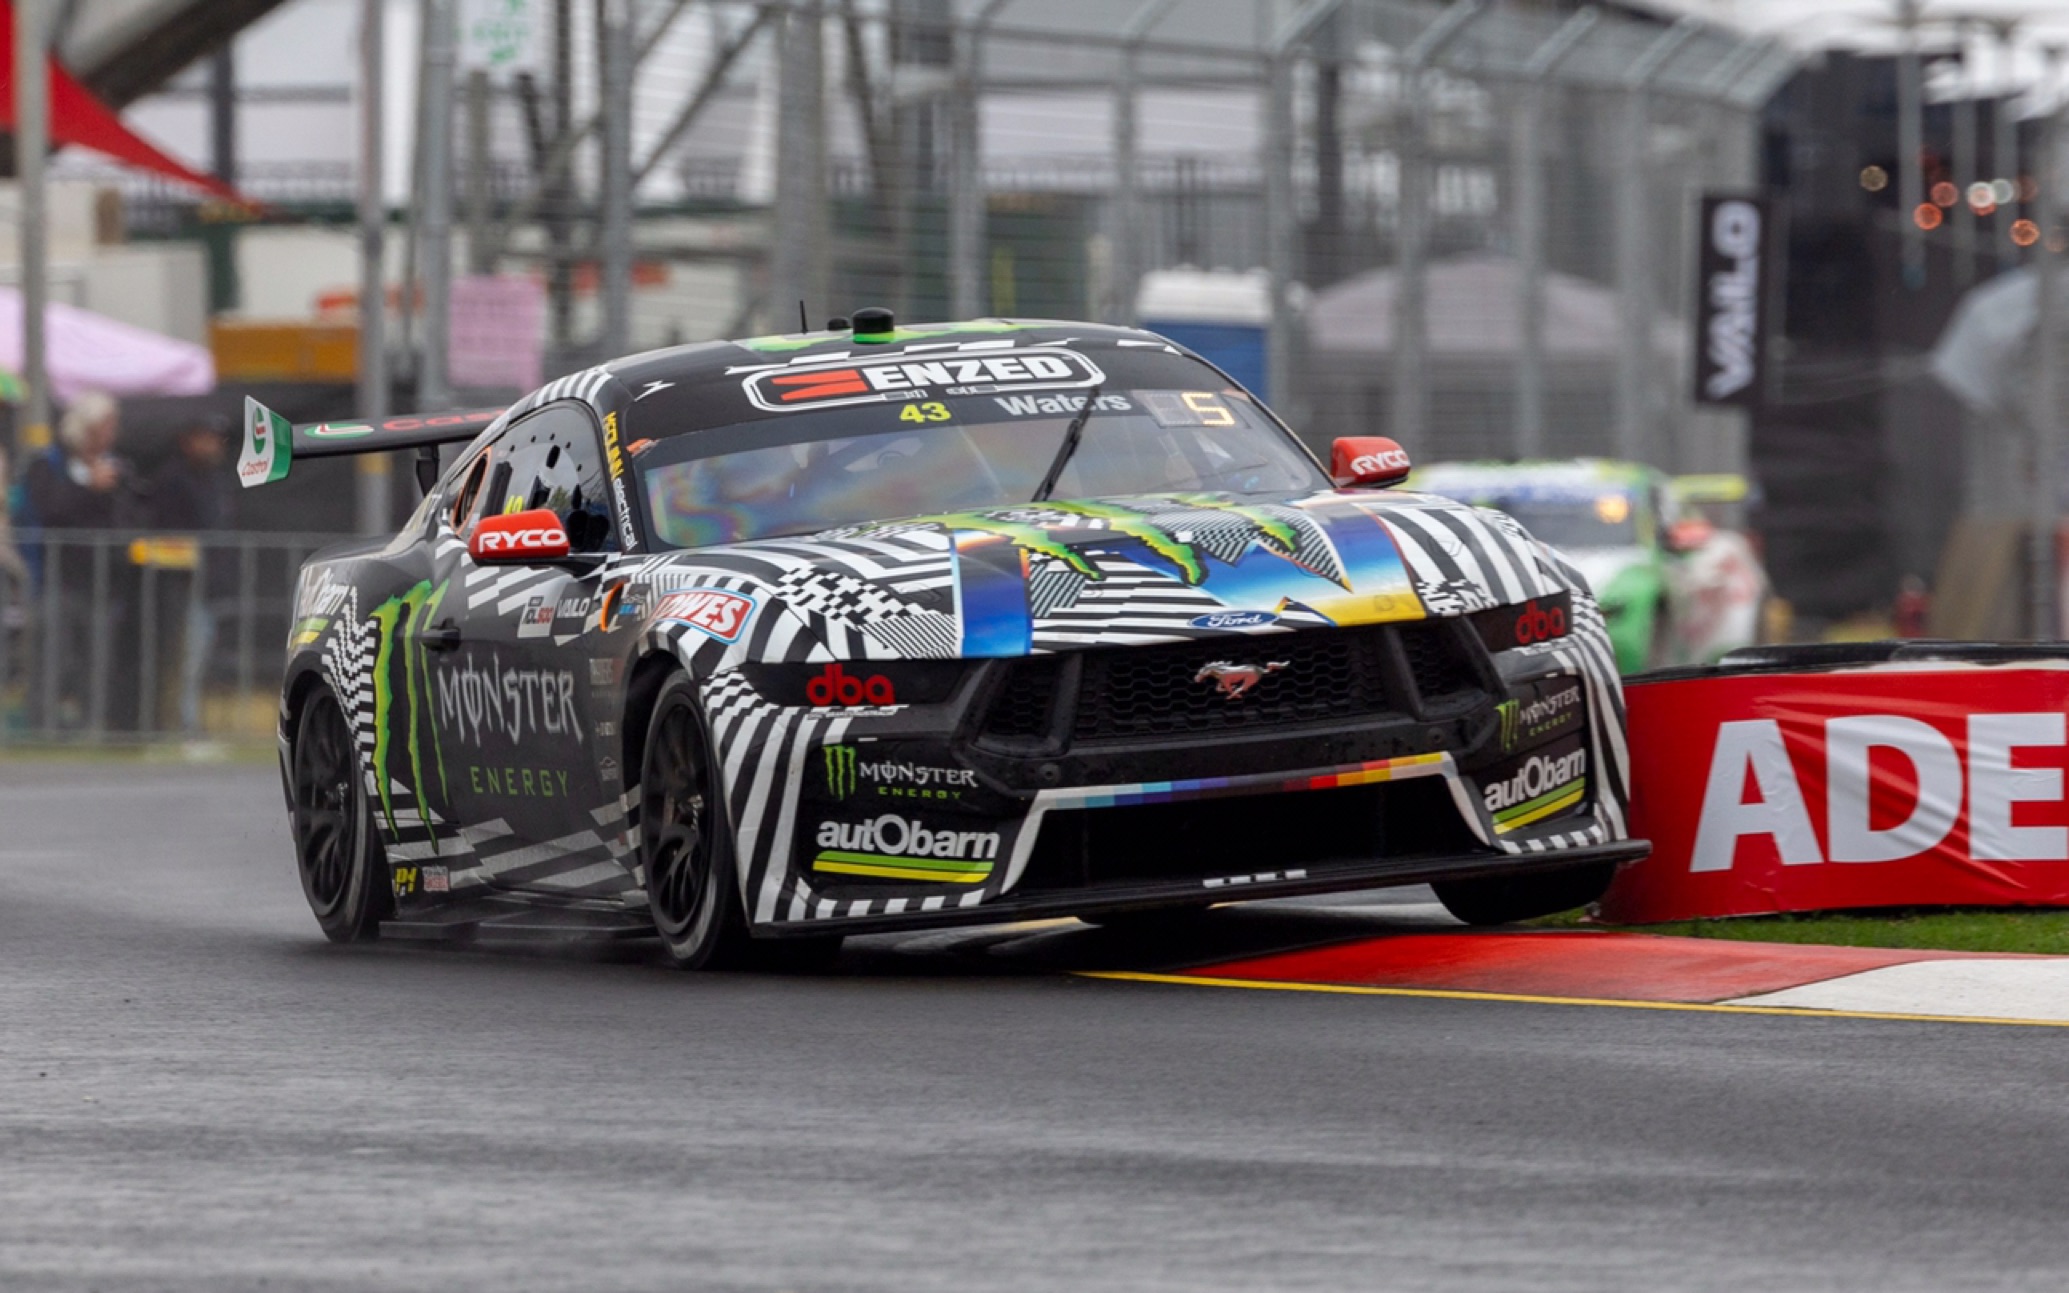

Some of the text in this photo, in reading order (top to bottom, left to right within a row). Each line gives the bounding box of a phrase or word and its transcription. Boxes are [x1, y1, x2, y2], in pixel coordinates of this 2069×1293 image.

[862, 356, 1073, 391] ENZED
[900, 402, 951, 424] 43
[993, 394, 1132, 416] Waters
[1350, 449, 1411, 476] RYCO
[478, 528, 569, 554] RYCO
[1207, 612, 1263, 628] Ford
[1515, 599, 1565, 644] dba
[806, 663, 896, 706] dba
[469, 766, 568, 797] ENERGY
[878, 786, 962, 799] ENERGY
[1690, 712, 2069, 872] ADE
[816, 814, 1000, 859] autObarn
